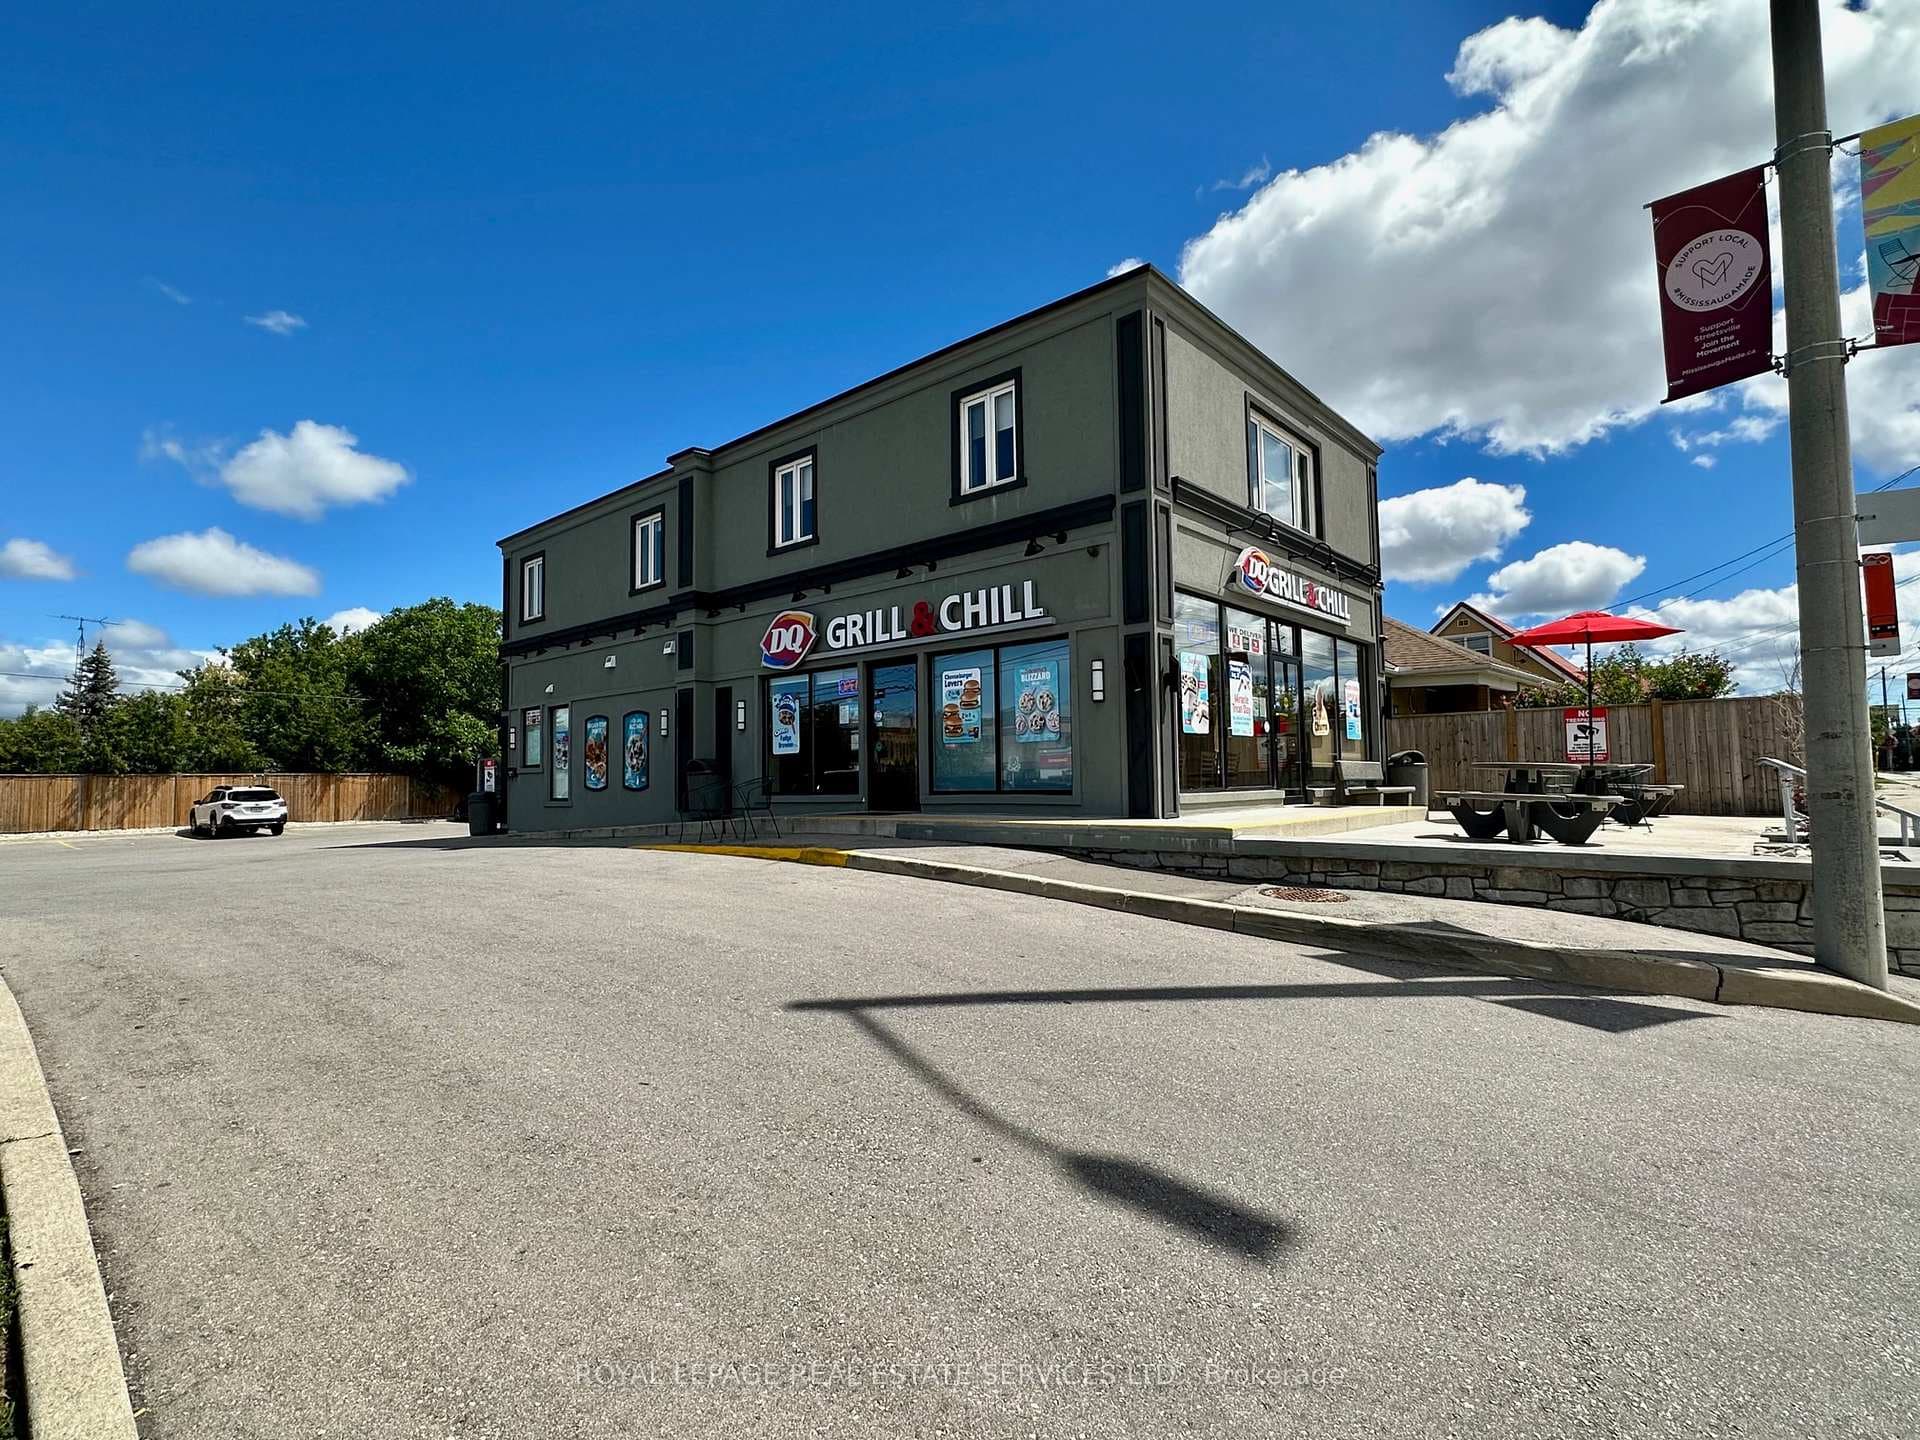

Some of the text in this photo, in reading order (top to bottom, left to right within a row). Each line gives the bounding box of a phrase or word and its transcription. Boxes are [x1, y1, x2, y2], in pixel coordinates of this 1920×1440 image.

[1675, 234, 1749, 268] SUPPORT LOCAL
[1674, 265, 1756, 307] #MISSISSAUGAMADE
[1694, 324, 1741, 343] Streetsville
[1700, 318, 1734, 333] Support
[1696, 340, 1740, 358] Movement
[1701, 335, 1735, 350] Join the
[1248, 556, 1351, 619] DQ GRILL & CHILL
[769, 580, 1044, 654] DQ GRILL & CHILL
